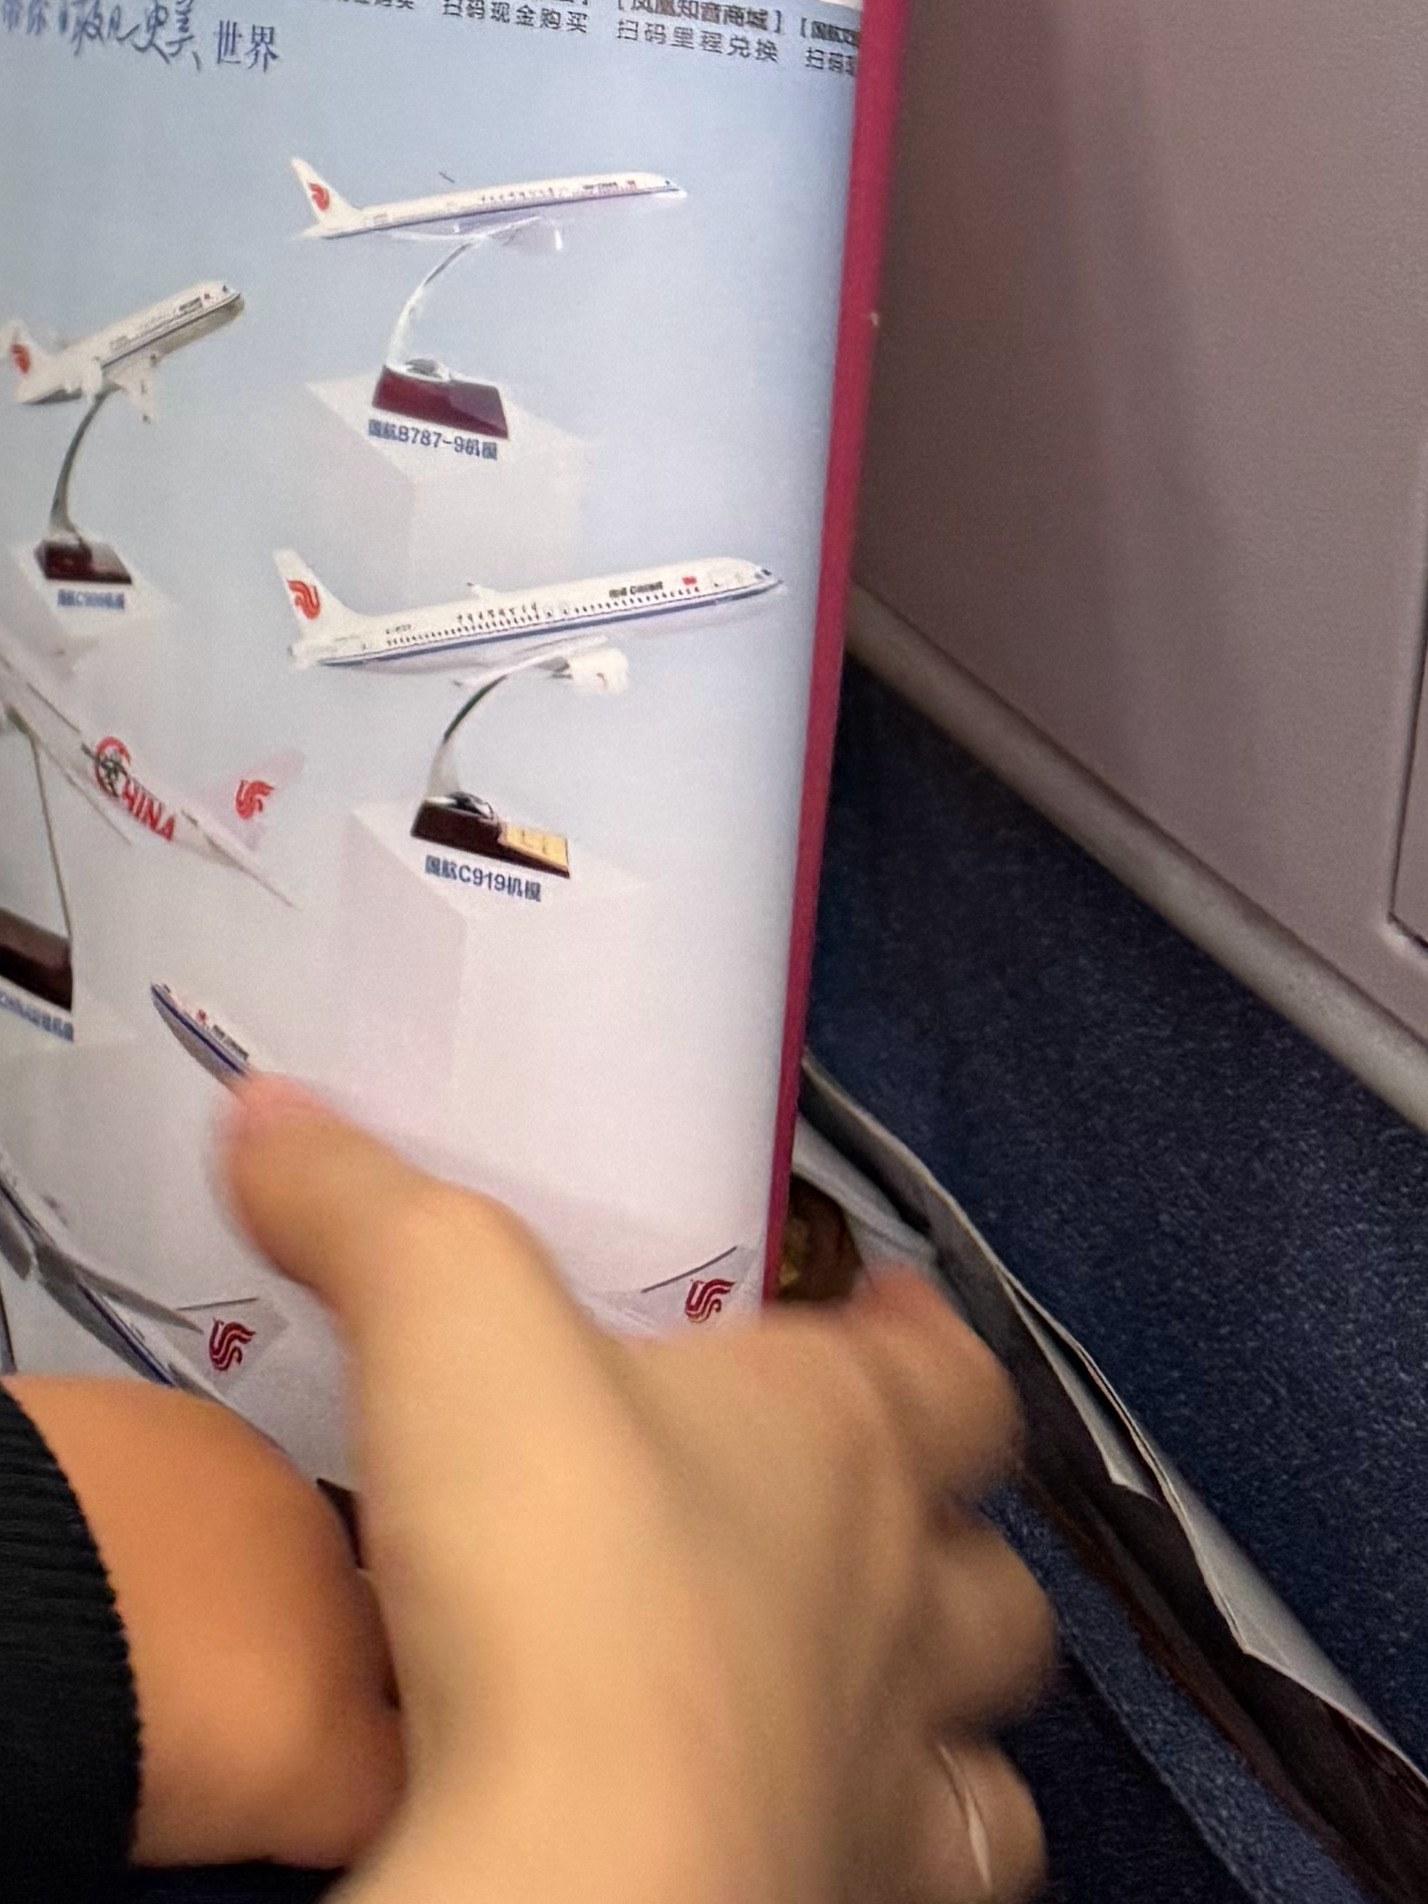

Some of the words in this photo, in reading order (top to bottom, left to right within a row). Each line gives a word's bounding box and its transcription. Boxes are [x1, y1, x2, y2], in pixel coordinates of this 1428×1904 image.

[616, 17, 779, 64] 扫码里程兑换
